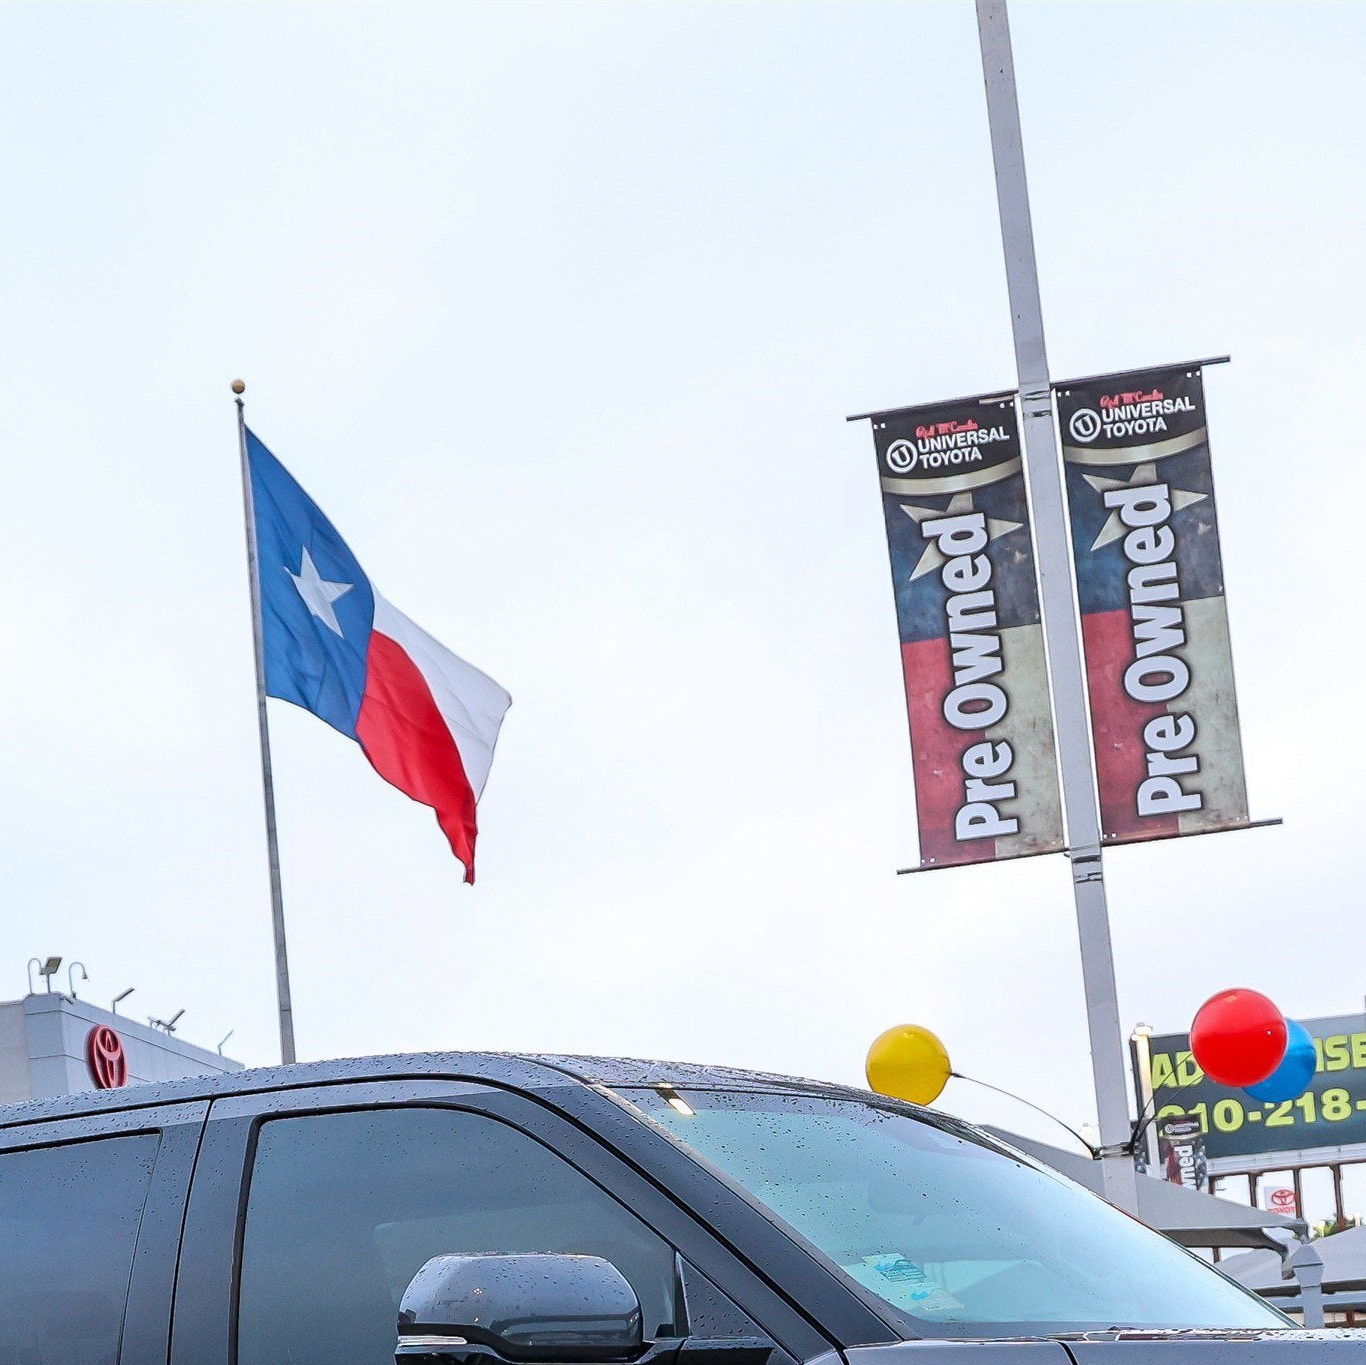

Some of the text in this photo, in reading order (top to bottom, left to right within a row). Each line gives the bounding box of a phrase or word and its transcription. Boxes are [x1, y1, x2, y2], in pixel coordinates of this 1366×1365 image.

[1101, 396, 1196, 423] UNIVERSAL
[917, 426, 1010, 453] UNIVERSAL
[1103, 416, 1167, 438] TOYOTA
[919, 446, 983, 469] TOYOTA
[1104, 483, 1203, 817] Pre Owned
[922, 512, 1021, 843] Pre Owned
